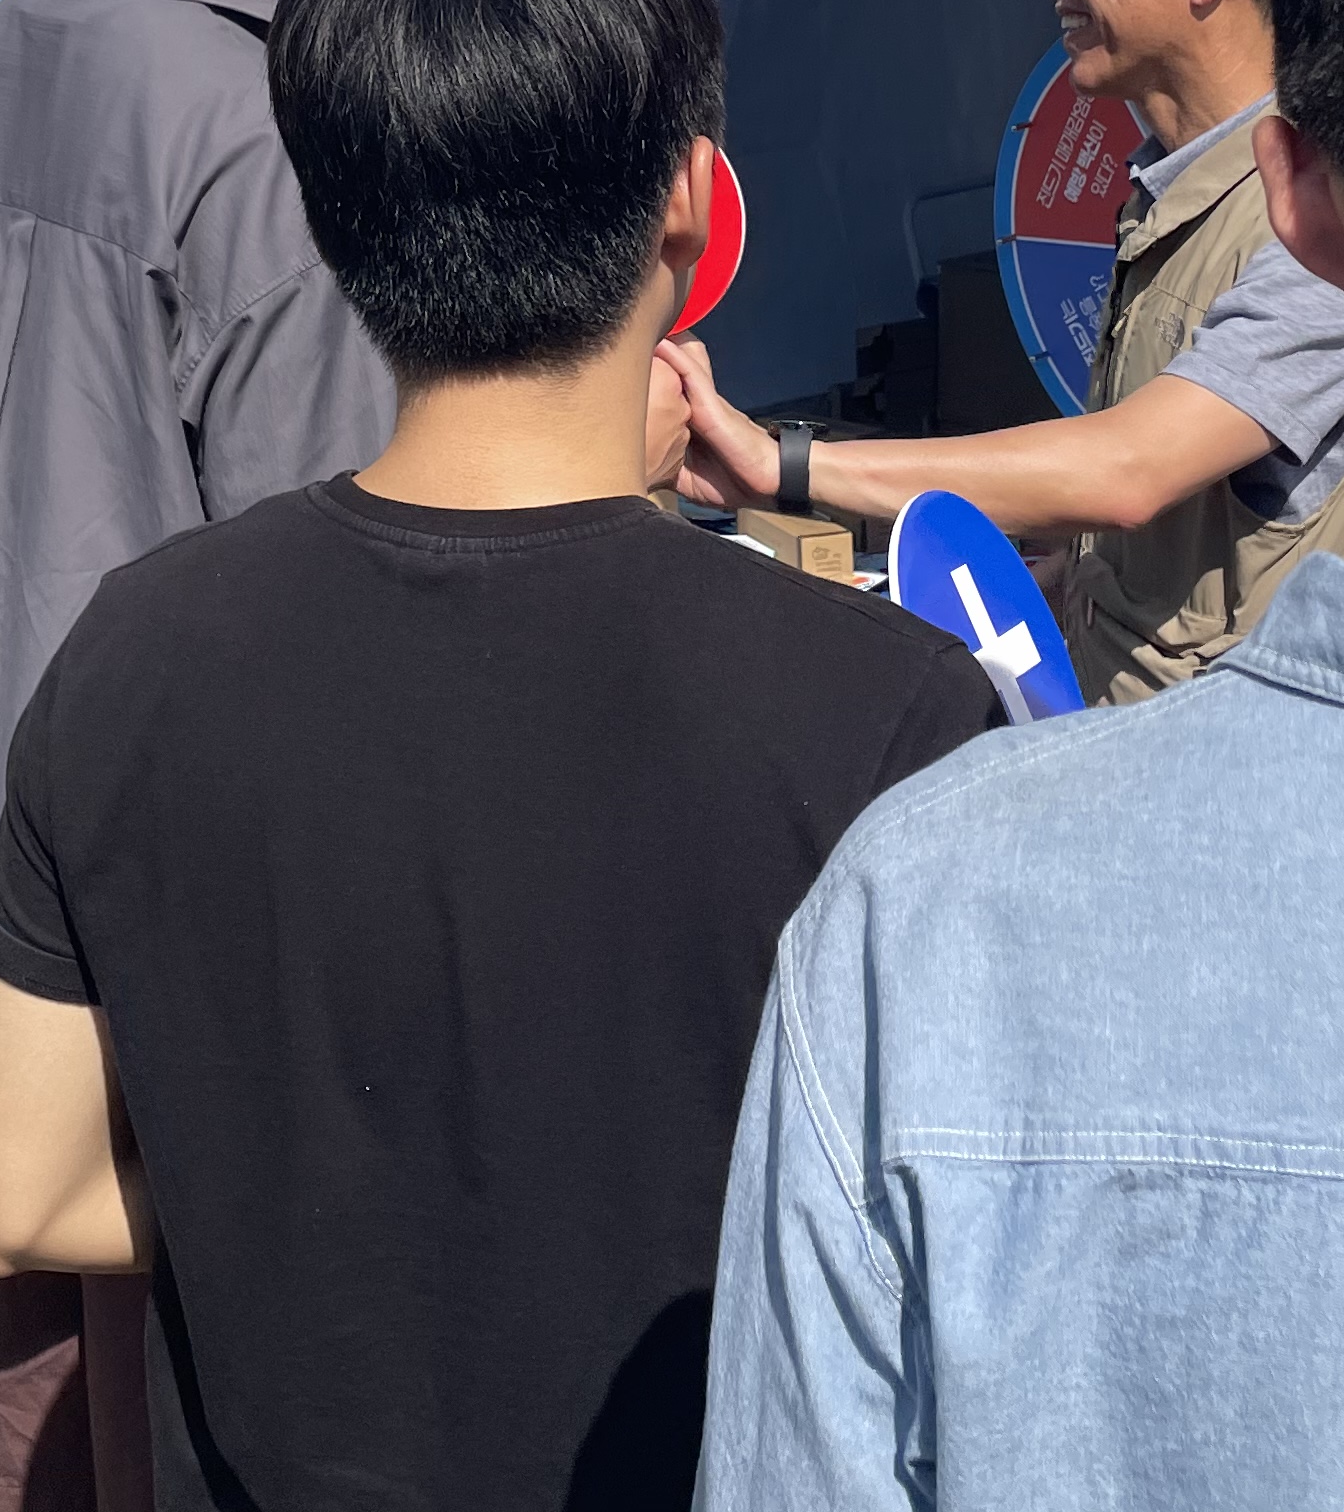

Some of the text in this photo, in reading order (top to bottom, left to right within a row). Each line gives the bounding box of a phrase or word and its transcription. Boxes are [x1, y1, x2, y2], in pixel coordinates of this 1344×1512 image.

[1036, 94, 1096, 209] 진드기 매개감염
[1063, 119, 1108, 203] 예방 백신이
[1090, 153, 1118, 199] 있다?
[1059, 297, 1098, 368] 진드기는
[1078, 294, 1104, 343] 숲을
